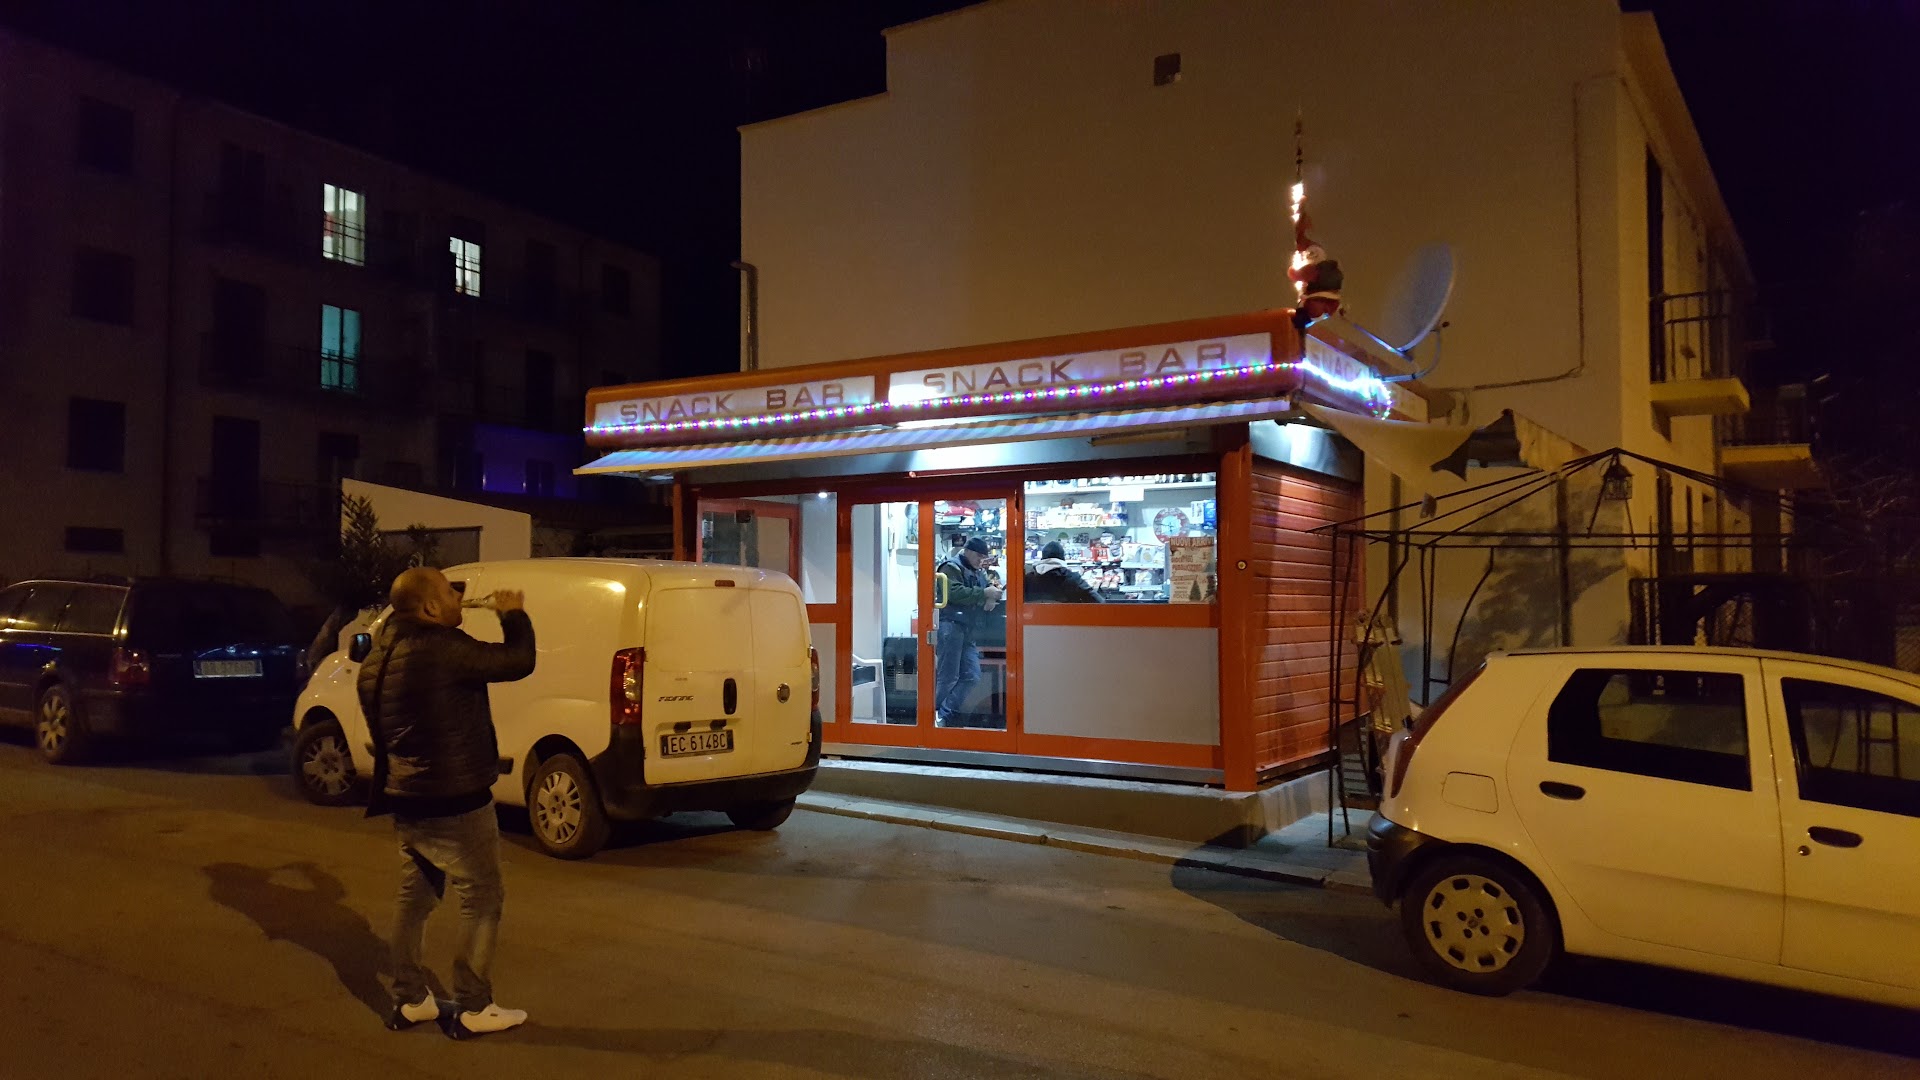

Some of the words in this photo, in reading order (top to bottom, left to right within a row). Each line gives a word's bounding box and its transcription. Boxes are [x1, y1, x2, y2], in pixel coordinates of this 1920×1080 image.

[921, 359, 1077, 394] SNACK
[1119, 343, 1227, 376] BAR
[620, 392, 735, 423] SNACK
[766, 383, 844, 410] BAR
[671, 736, 686, 753] EC
[690, 733, 726, 751] 614BC
